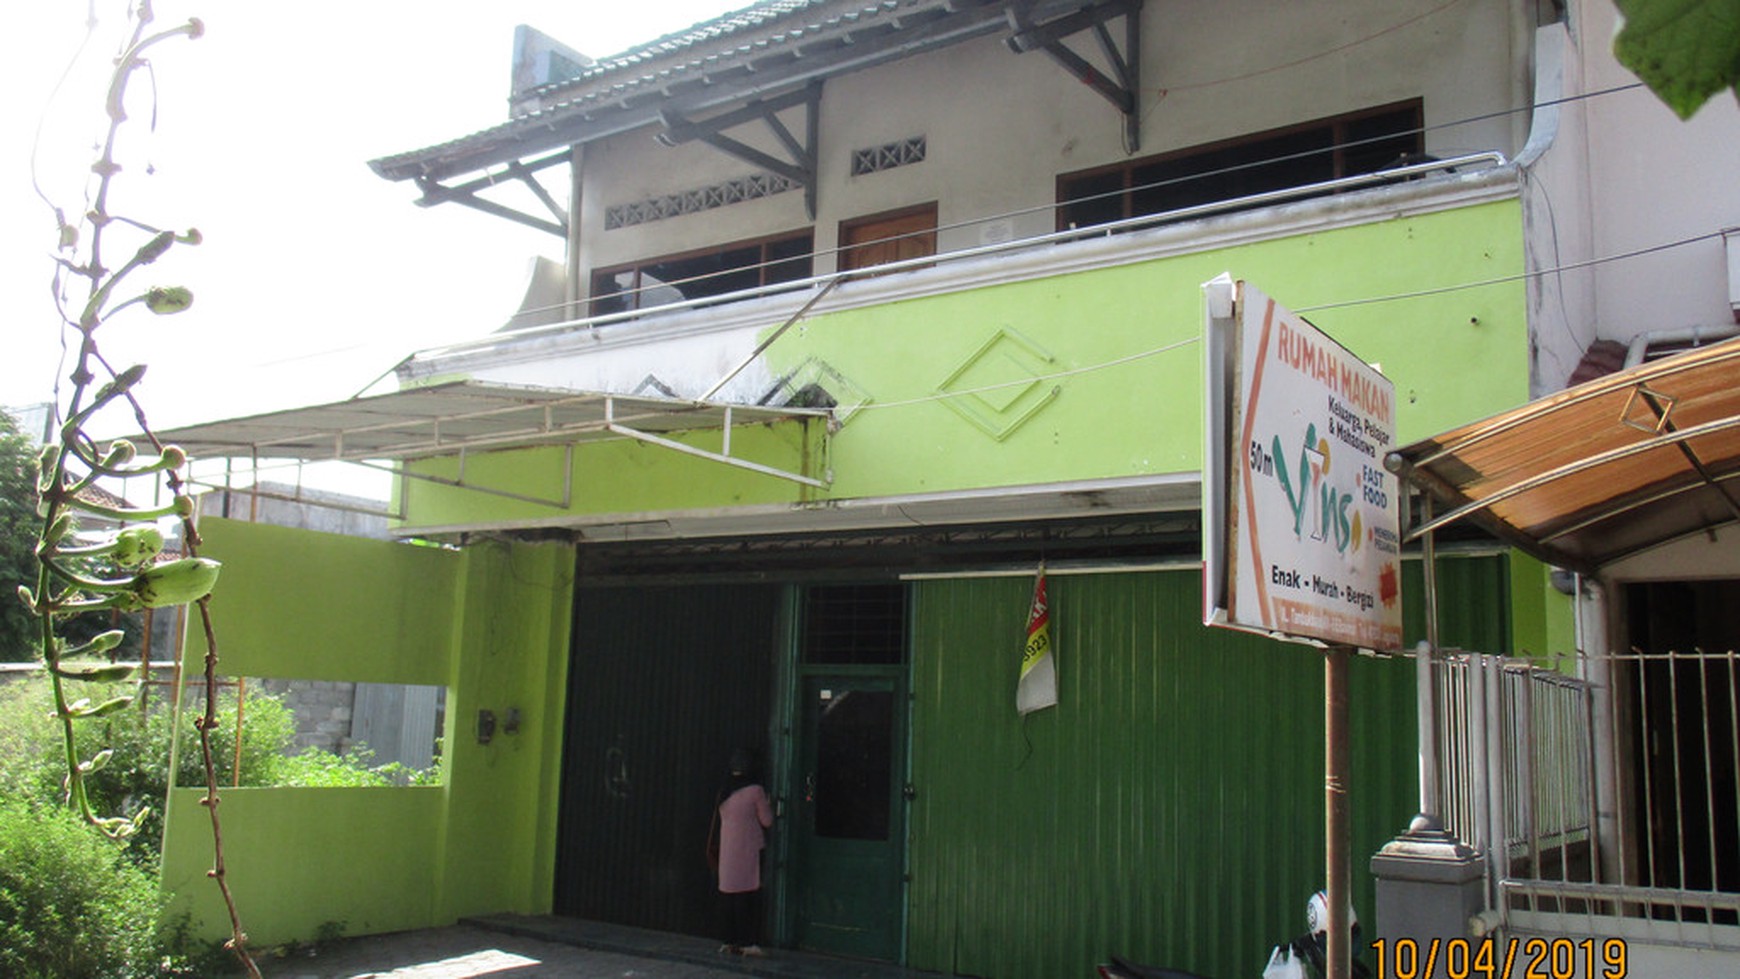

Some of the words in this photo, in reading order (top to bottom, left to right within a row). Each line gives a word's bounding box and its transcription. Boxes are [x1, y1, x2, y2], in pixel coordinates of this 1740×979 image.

[1278, 321, 1338, 392] RUMAH
[1341, 362, 1389, 424] MAKAN
[1328, 416, 1335, 435] &
[1336, 421, 1376, 458] Mahasiswa
[1364, 418, 1389, 446] Pelajar
[1363, 464, 1384, 489] FAST
[1363, 485, 1388, 510] FOOD
[1272, 564, 1301, 589] Enak
[1313, 574, 1339, 599] Murah
[1346, 585, 1374, 611] Bergizi
